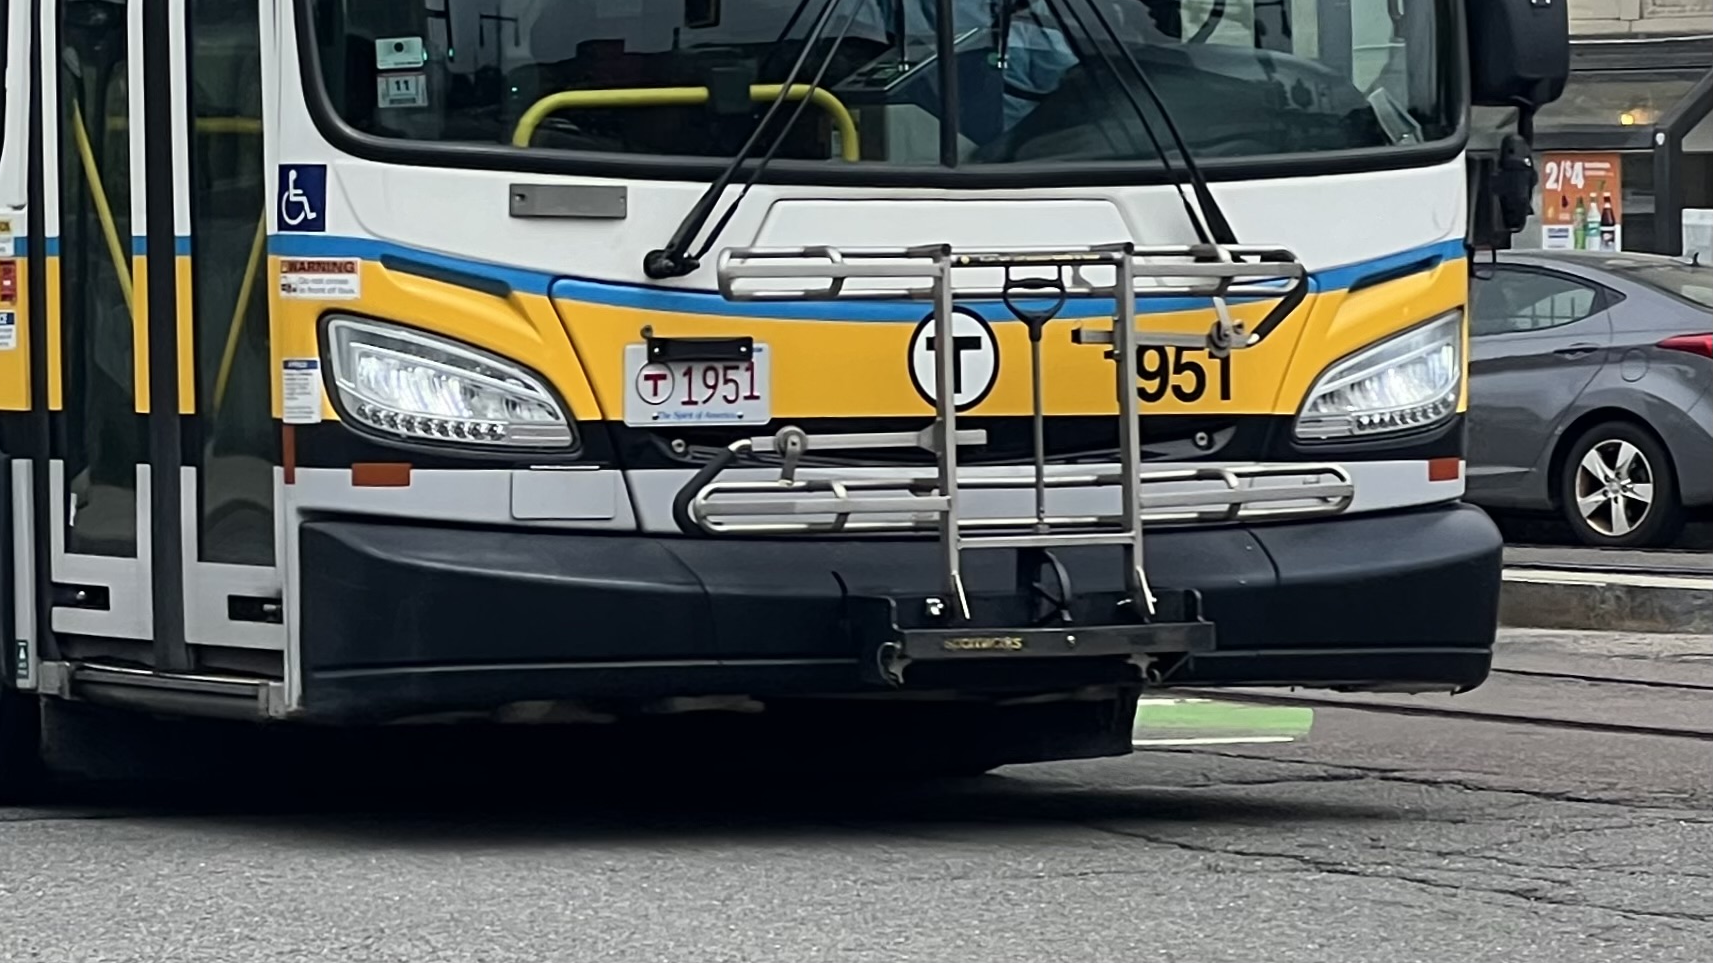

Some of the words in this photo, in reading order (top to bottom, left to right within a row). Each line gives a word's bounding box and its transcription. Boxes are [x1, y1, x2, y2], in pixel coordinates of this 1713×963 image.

[394, 79, 410, 92] 11
[288, 260, 356, 274] WARNING
[643, 373, 668, 397] T
[680, 361, 761, 406] 1951
[925, 336, 982, 395] T
[1104, 344, 1232, 403] 951
